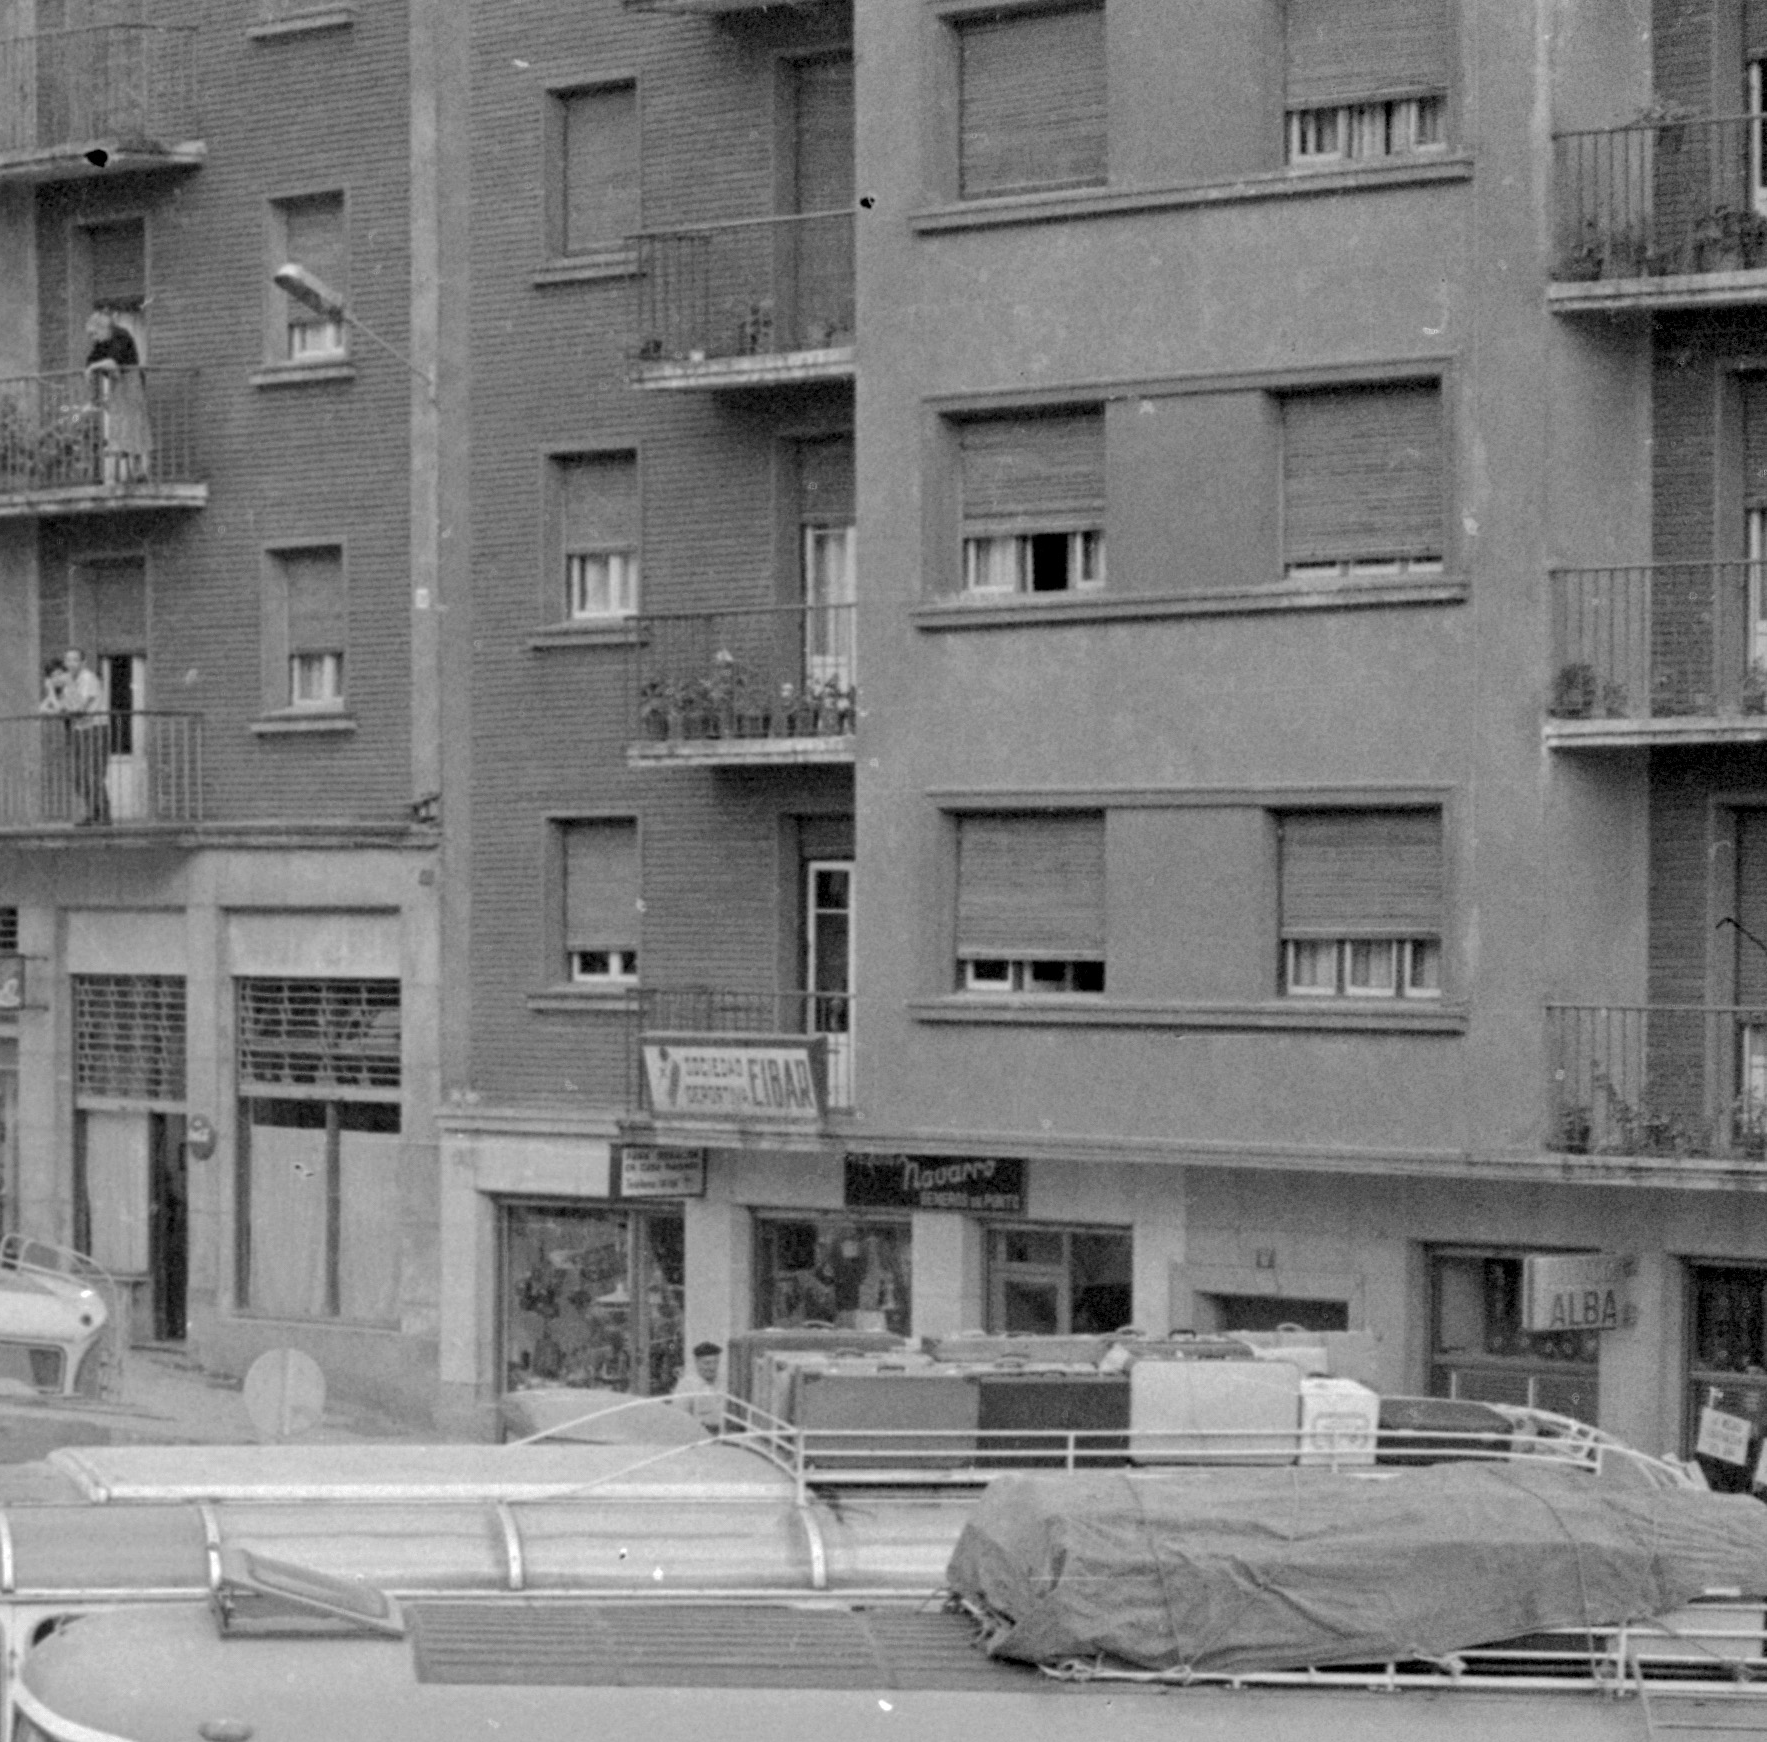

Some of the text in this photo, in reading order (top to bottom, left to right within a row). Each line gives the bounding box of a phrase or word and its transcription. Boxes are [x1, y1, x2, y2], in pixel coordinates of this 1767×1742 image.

[684, 1056, 743, 1078] SOCIEDAD
[746, 1057, 816, 1109] EIBAR
[685, 1084, 749, 1104] DEPORTIVA
[902, 1158, 997, 1192] Navarro
[1549, 1289, 1617, 1326] ALBA
